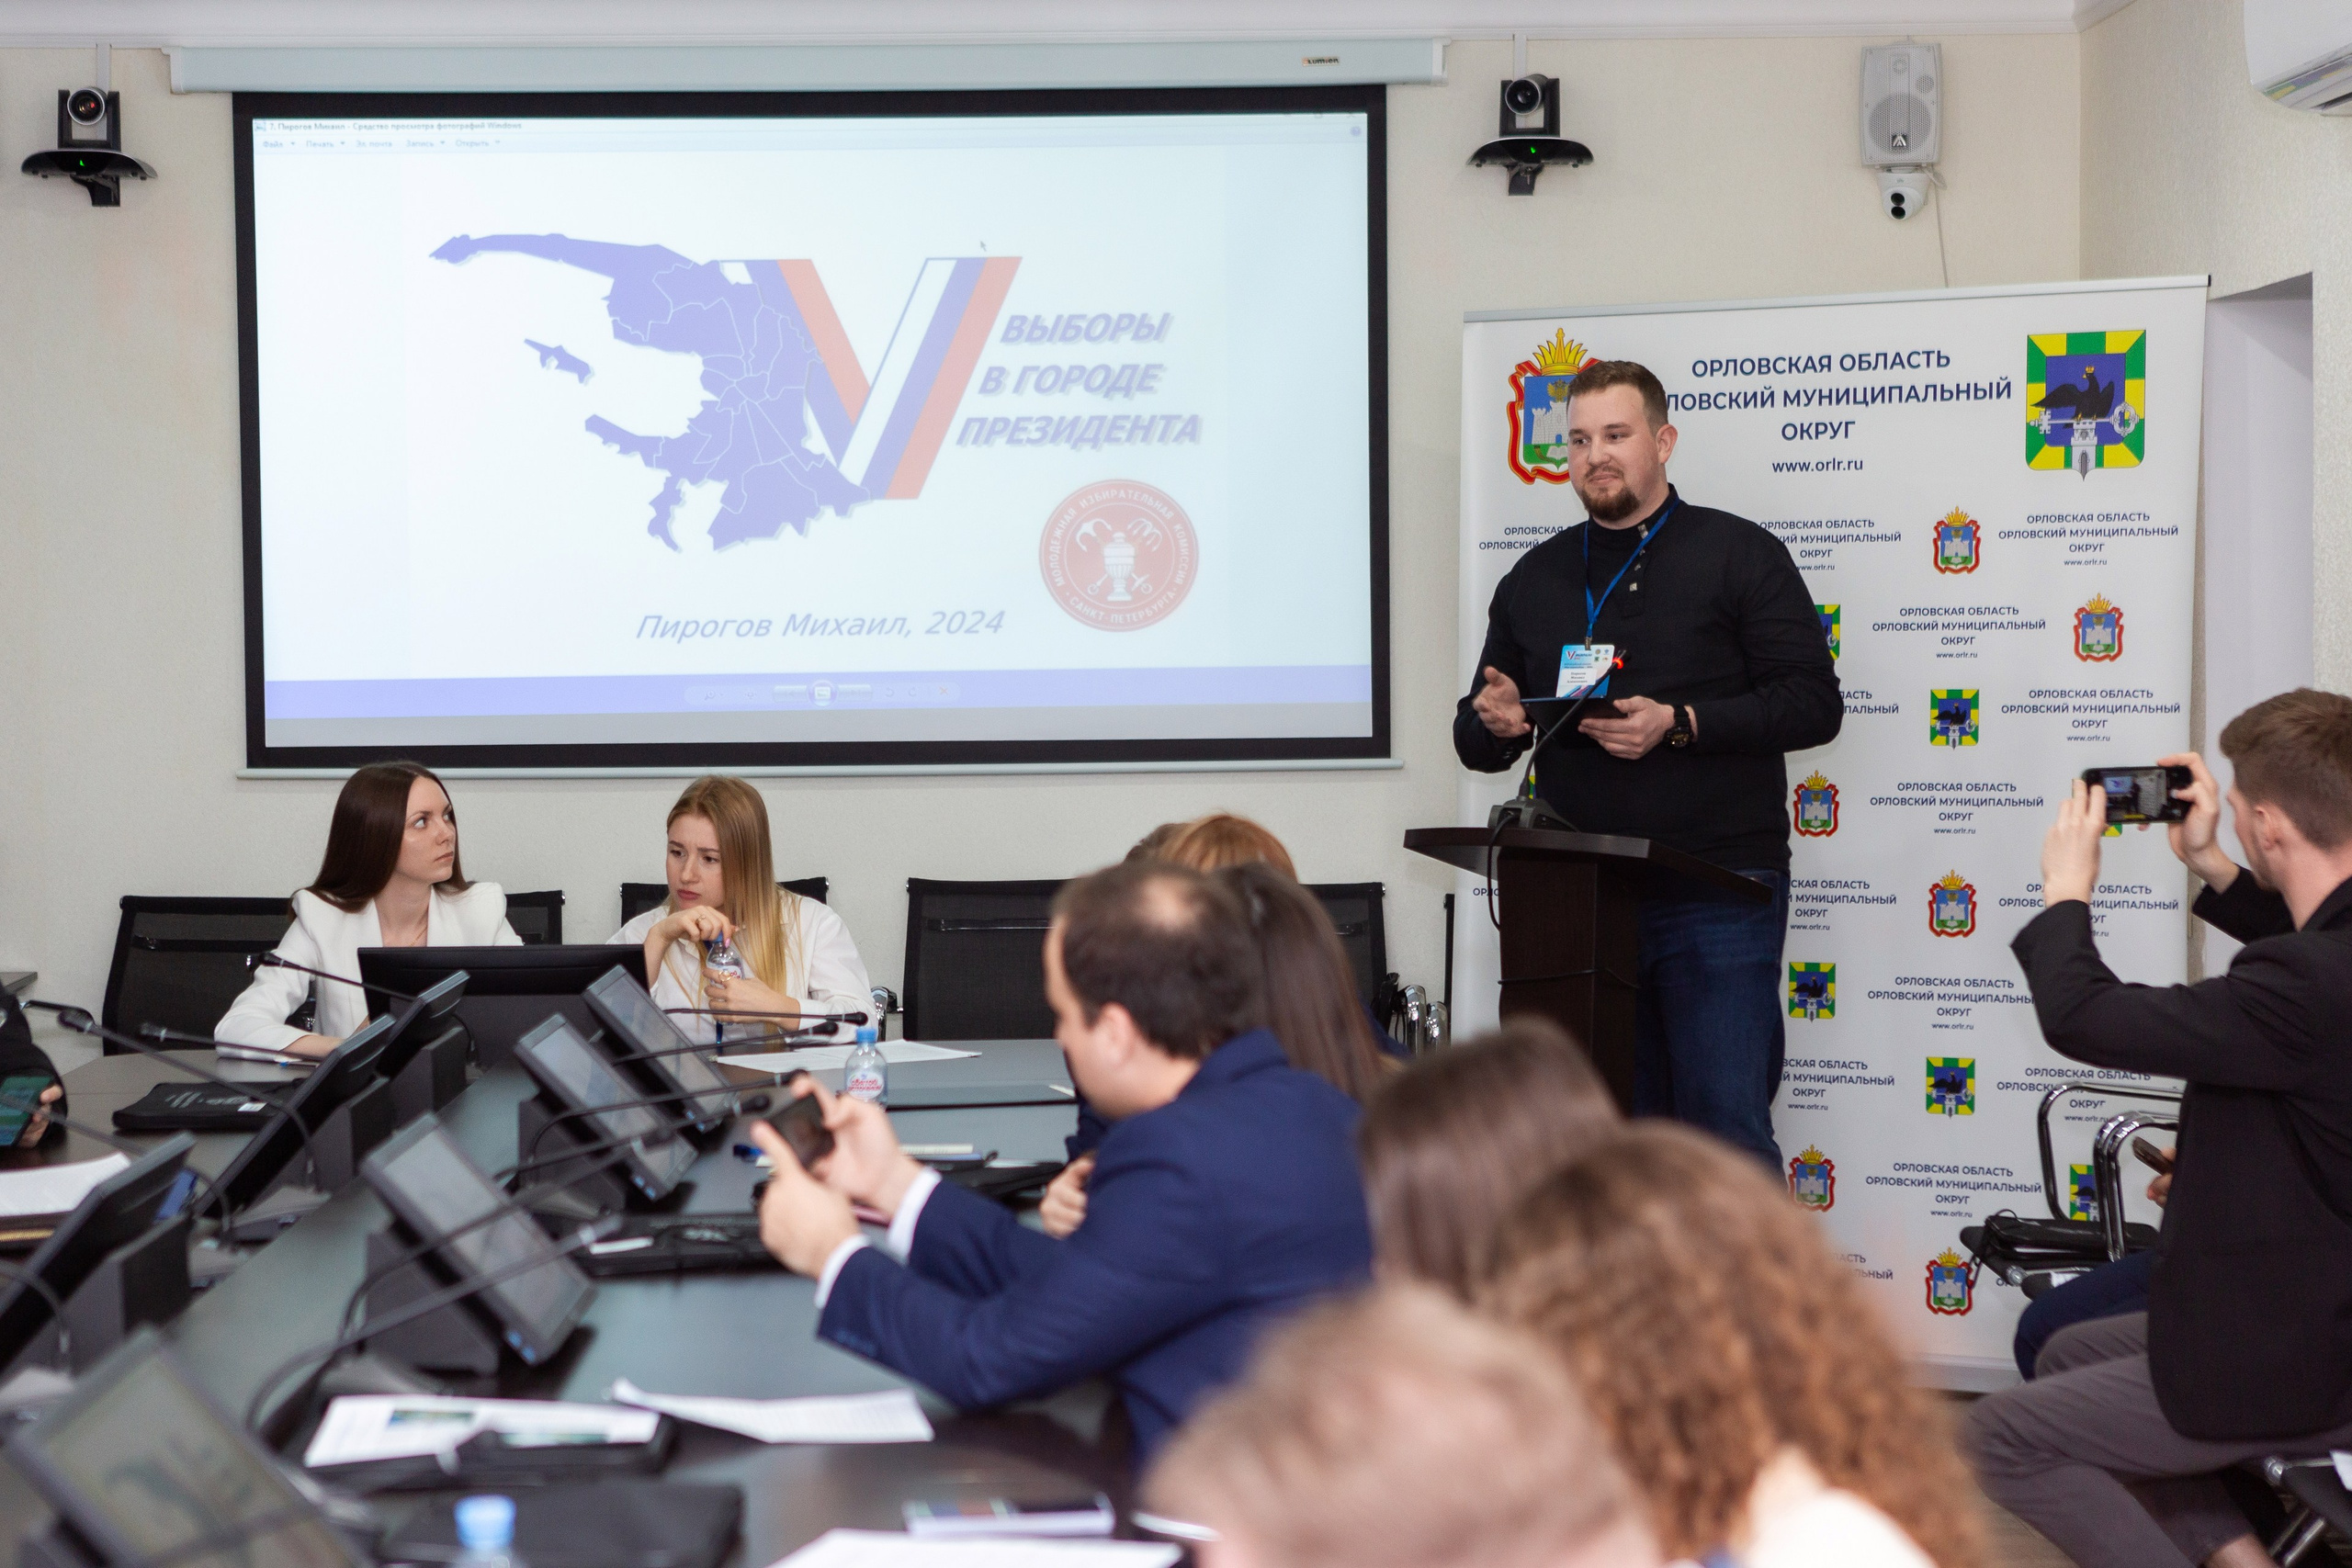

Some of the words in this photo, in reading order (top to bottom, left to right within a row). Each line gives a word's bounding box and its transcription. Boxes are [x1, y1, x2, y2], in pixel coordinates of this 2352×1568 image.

[487, 121, 522, 130] Windows
[1000, 312, 1172, 344] ВЫБОРЫ
[1692, 355, 1831, 378] ОРЛОВСКАЯ
[1839, 350, 1951, 372] ОБЛАСТЬ
[978, 366, 1008, 396] В
[1012, 364, 1165, 399] ГОРОДЕ
[1667, 386, 1775, 412] ЛОВСКИЙ
[1783, 377, 2012, 407] МУНИЦИПАЛЬНЫЙ
[956, 414, 1201, 451] ПРЕЗИДЕНТА
[1781, 421, 1855, 441] ОКРУГ
[1772, 457, 1862, 472] www.orlr.ru
[1826, 519, 1874, 528] ОБЛАСТЬ
[2027, 513, 2093, 524] ОРЛОВСКАЯ
[2097, 513, 2150, 522] ОБЛАСТЬ
[1079, 489, 1175, 521] ИЗБИРАТЕЛЬНАЯ
[1172, 523, 1190, 585] КОМИССИЯ
[1999, 527, 2065, 539] ОРЛОВСКИЙ
[2070, 525, 2178, 538] МУНИЦИПАЛЬНЫЙ
[1801, 532, 1901, 544] МУНИЦИПАЛЬНЫЙ
[1800, 549, 1833, 558] ОКРУГ
[2069, 544, 2105, 552] ОКРУГ
[1900, 607, 1964, 616] ОРЛОВСКАЯ
[1968, 607, 2018, 615] ОБЛАСТЬ
[636, 615, 773, 643] Пирогов
[782, 613, 913, 638] Михаил,
[924, 610, 1007, 635] 2024
[1872, 620, 1938, 631] ОРЛОВСКИЙ
[1942, 619, 2045, 631] МУНИЦИПАЛЬНЫЙ
[1941, 637, 1975, 645] ОКРУГ
[1839, 691, 1872, 699] ЛАСТЬ
[2029, 690, 2097, 698] ОРЛОВСКАЯ
[2100, 690, 2153, 698] ОБЛАСТЬ
[1844, 703, 1899, 714] ПАЛЬНЫЙ
[2001, 703, 2069, 714] ОРЛОВСКИЙ
[2073, 703, 2180, 715] МУНИЦИПАЛЬНЫЙ
[2072, 719, 2108, 728] ОКРУГ
[1897, 783, 1962, 791] ОРЛОВСКАЯ
[1966, 784, 2017, 792] ОБЛАСТЬ
[1870, 795, 1936, 806] ОРЛОВСКИЙ
[1939, 796, 2043, 807] МУНИЦИПАЛЬНЫЙ
[1939, 812, 1973, 821] ОКРУГ
[1820, 880, 1870, 889] ОБЛАСТЬ
[2098, 885, 2152, 894] ОБЛАСТЬ
[1795, 894, 1896, 905] МУНИЦИПАЛЬНЫЙ
[1998, 897, 2044, 908] ОРЛОВС
[2090, 899, 2179, 910] НИЦИПАЛЬНЫЙ
[1795, 908, 1827, 918] ОКРУГ
[1895, 976, 1961, 987] ОРЛОВСКАЯ
[1963, 978, 2014, 988] ОБЛАСТЬ
[1868, 990, 1934, 1001] ОРЛОВСКИЙ
[1937, 993, 2035, 1004] МУНИЦИПАЛЬНЫ
[1937, 1008, 1972, 1017] ОКРУГ
[1782, 1059, 1815, 1067] ВСКАЯ
[1818, 1060, 1868, 1069] ОБЛАСТЬ
[2025, 1067, 2094, 1078] ОРЛОВСКАЯ
[1793, 1074, 1894, 1086] МУНИЦИПАЛЬНЫЙ
[1792, 1088, 1826, 1097] ОКРУГ
[1894, 1163, 1959, 1174] ОРЛОВСКАЯ
[1962, 1166, 2013, 1177] ОБЛАСТЬ
[1866, 1176, 1932, 1188] ОРЛОВСКИЙ
[1936, 1179, 2042, 1193] МУНИЦИПАЛЬНЫЙ
[1935, 1194, 1970, 1204] ОКРУГ
